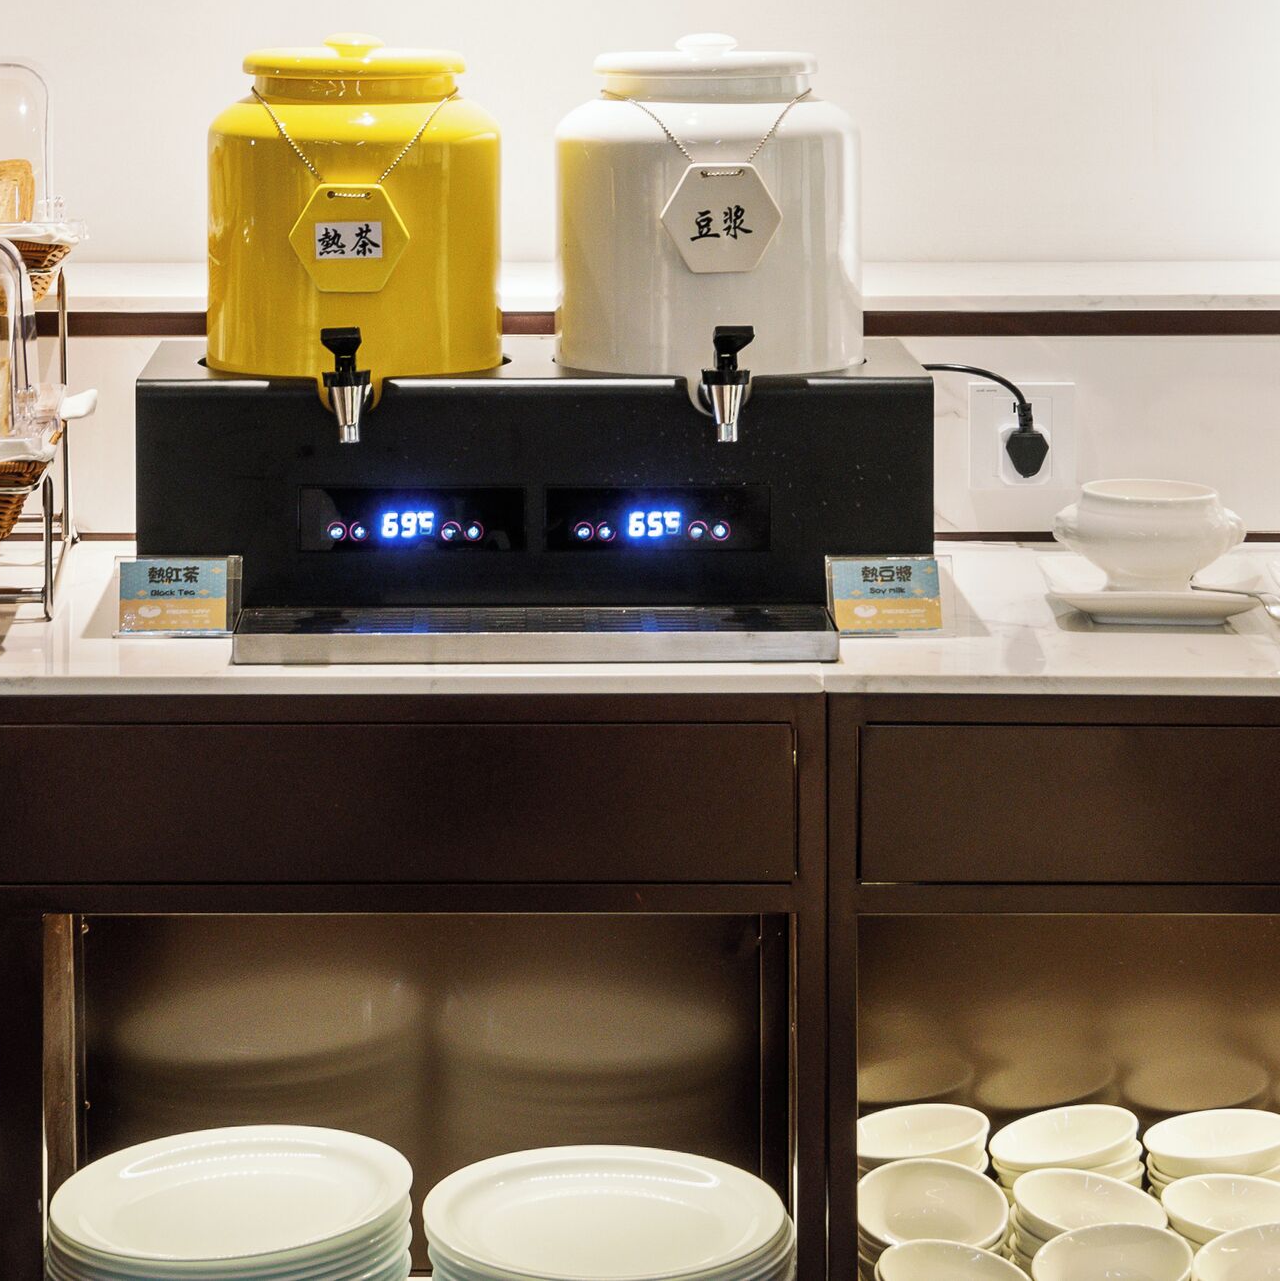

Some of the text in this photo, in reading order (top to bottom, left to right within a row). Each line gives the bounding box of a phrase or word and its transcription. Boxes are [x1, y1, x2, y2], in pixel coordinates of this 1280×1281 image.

[148, 566, 200, 584] 熱紅茶
[150, 589, 196, 597] Black Tea
